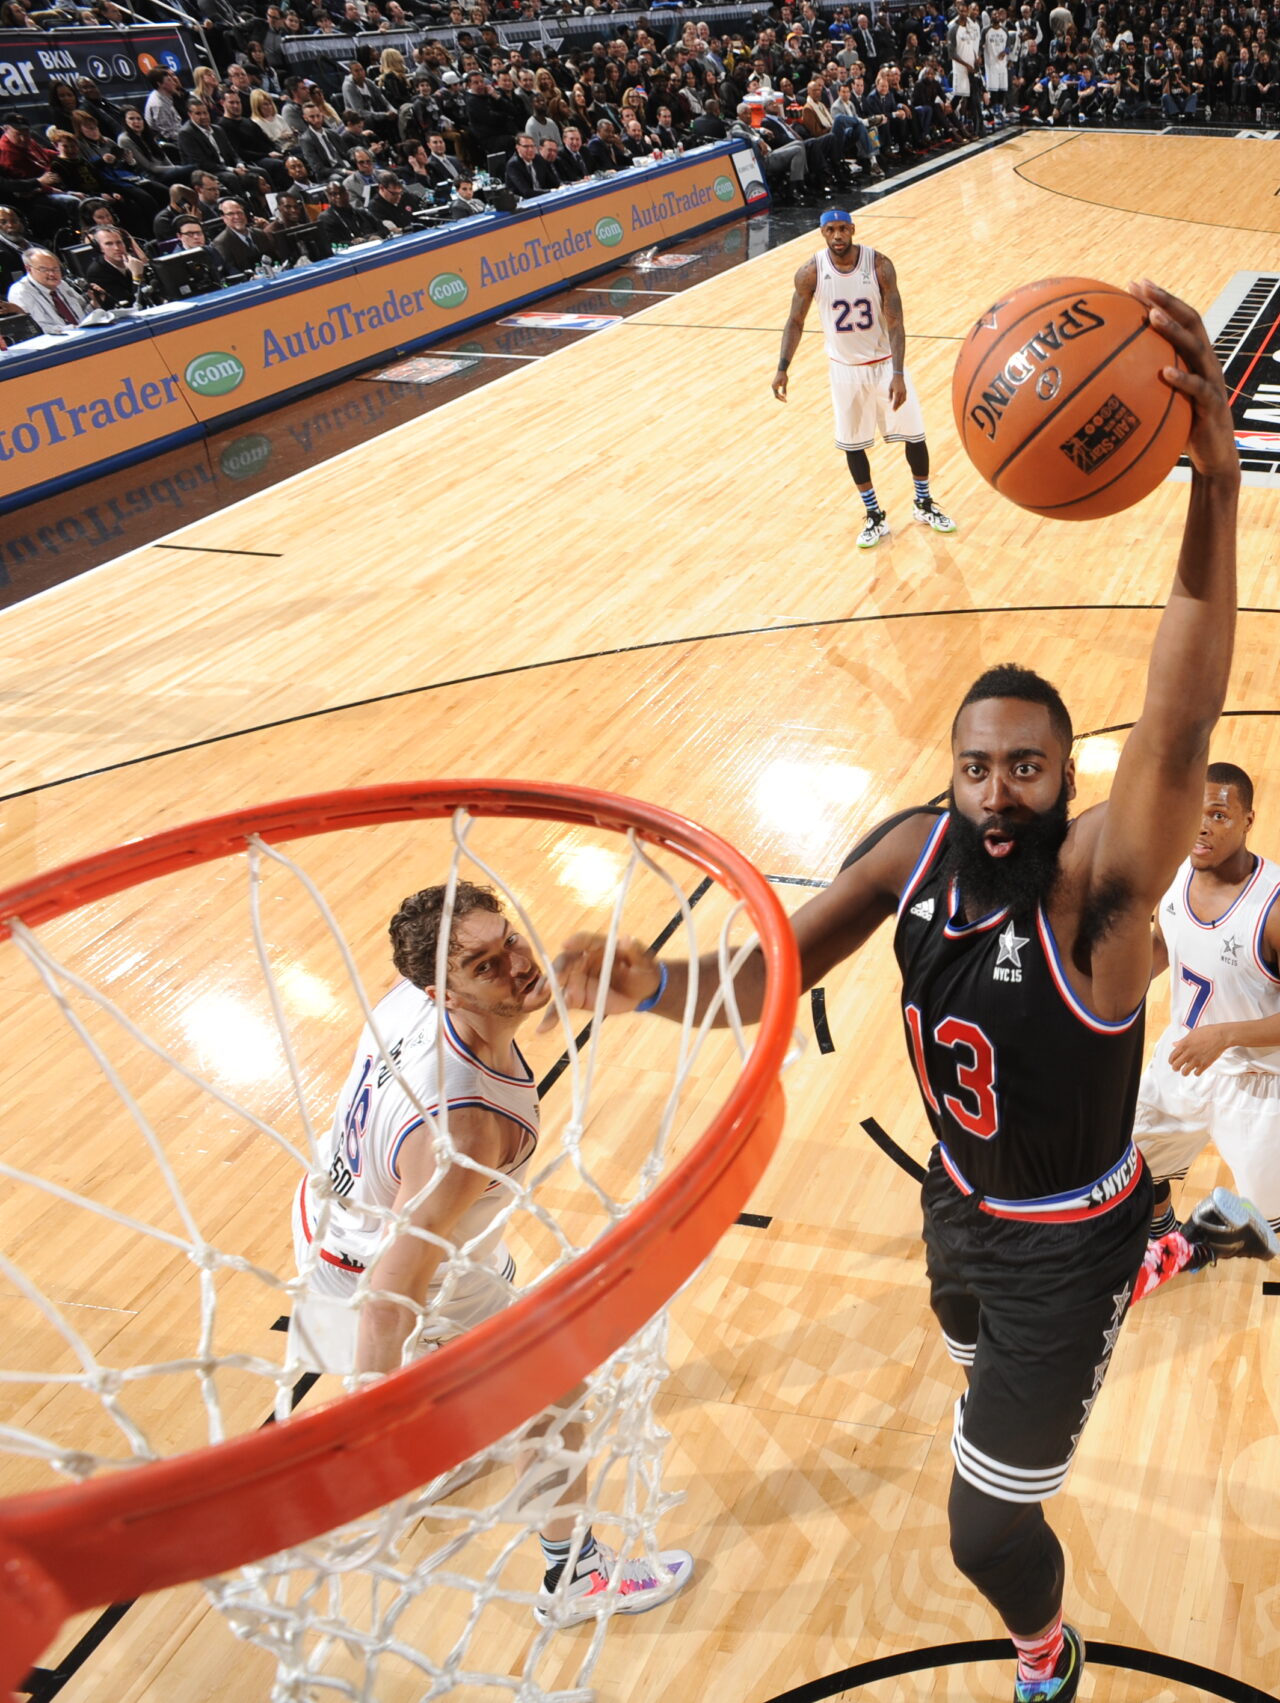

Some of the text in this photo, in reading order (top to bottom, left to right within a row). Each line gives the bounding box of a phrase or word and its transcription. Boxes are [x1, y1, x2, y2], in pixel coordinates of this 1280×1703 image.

[0, 60, 40, 96] ar
[37, 49, 77, 69] BKN
[631, 183, 713, 231] AutoTrader
[479, 227, 593, 288] AutoTrader
[262, 286, 424, 368] AutoTrader
[832, 297, 874, 333] 23
[970, 298, 1105, 442] SPALDING
[1180, 962, 1214, 1030] 7
[905, 1001, 999, 1140] 13
